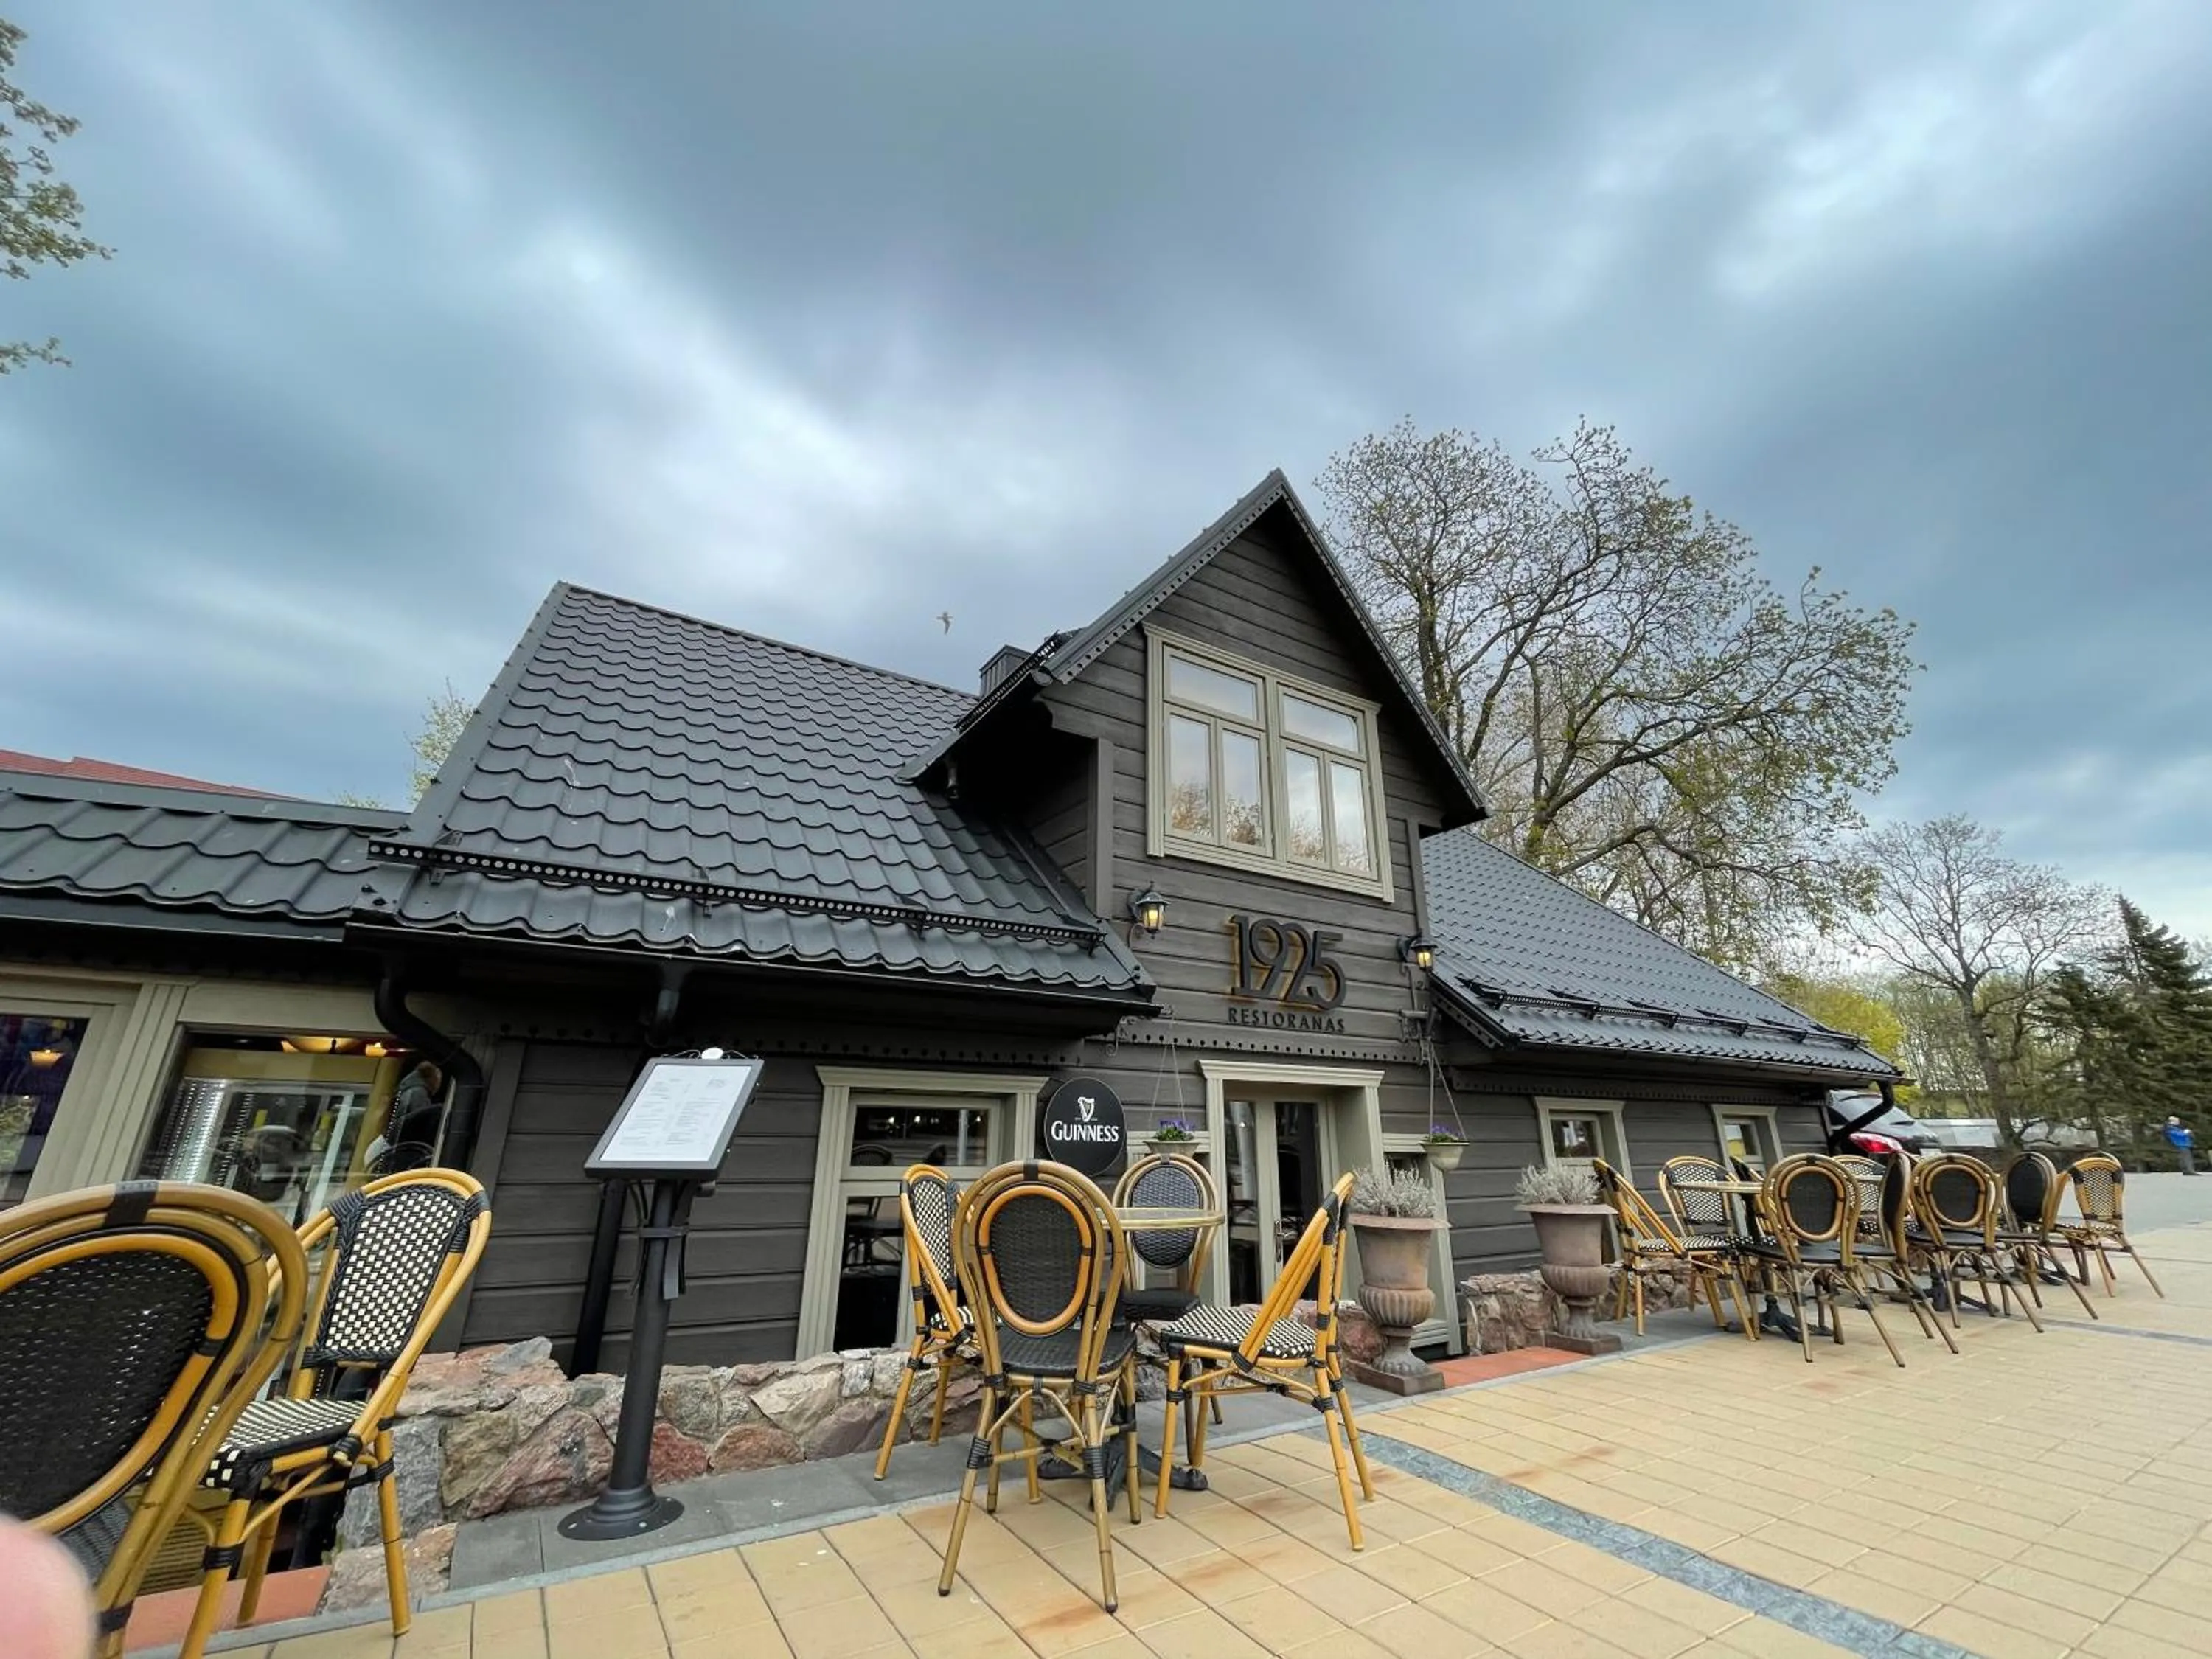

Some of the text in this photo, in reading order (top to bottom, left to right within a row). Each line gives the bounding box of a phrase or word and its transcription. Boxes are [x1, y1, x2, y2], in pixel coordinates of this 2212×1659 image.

[1229, 915, 1346, 1010] 1925
[1228, 1007, 1345, 1032] RESTORANAS
[1051, 1120, 1119, 1142] GUINNESS
